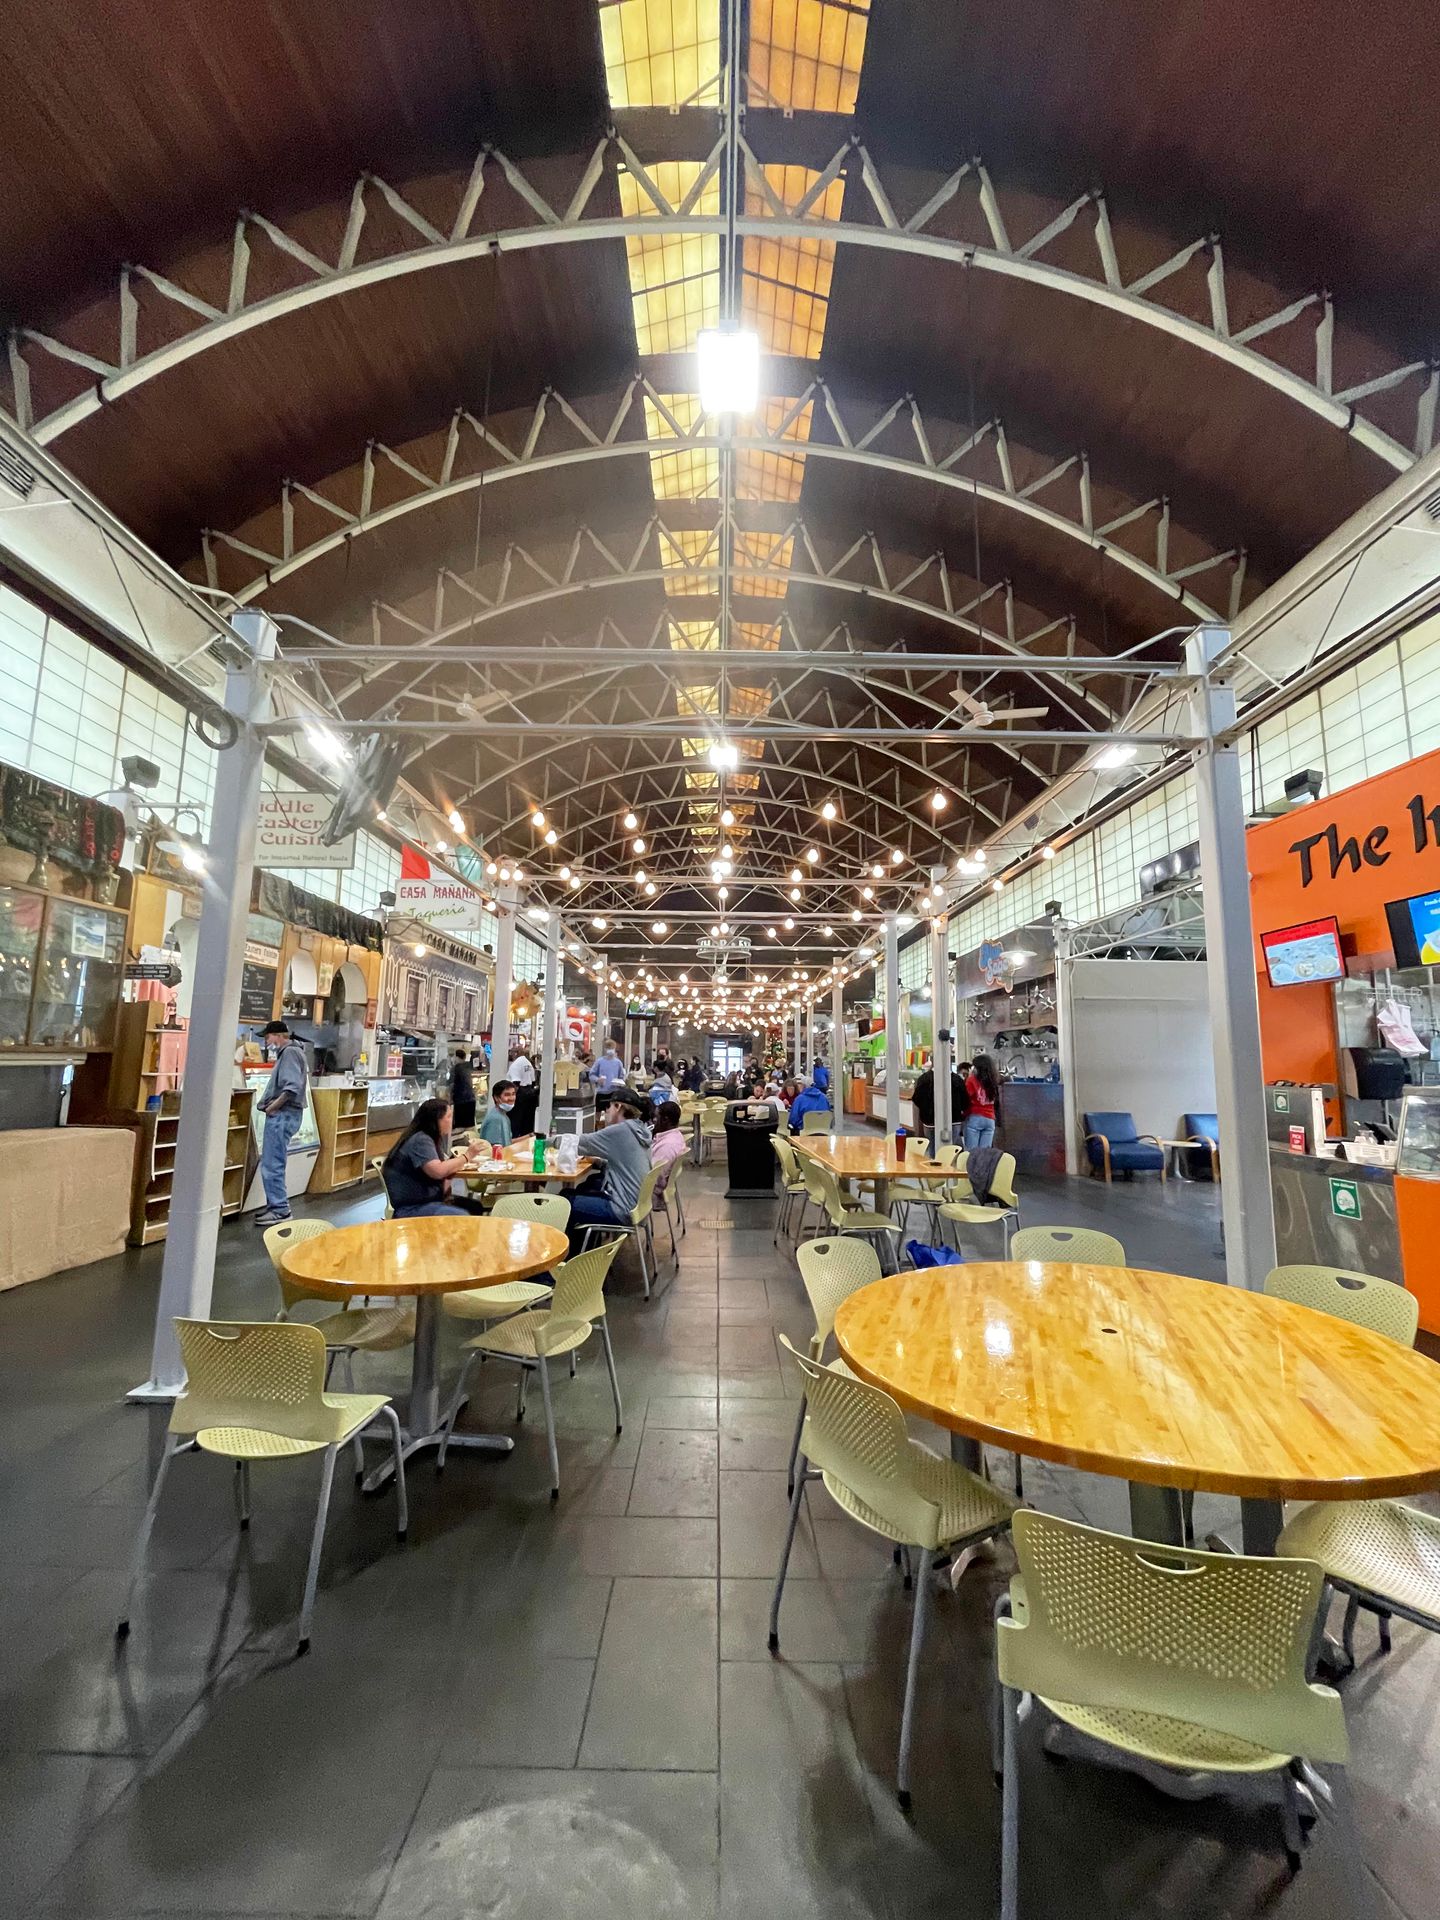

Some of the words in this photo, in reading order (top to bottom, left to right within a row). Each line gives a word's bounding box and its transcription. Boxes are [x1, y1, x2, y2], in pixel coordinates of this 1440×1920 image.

[259, 800, 314, 813] iddle
[1288, 822, 1391, 889] The
[400, 886, 427, 899] CASA
[426, 933, 447, 953] CASA
